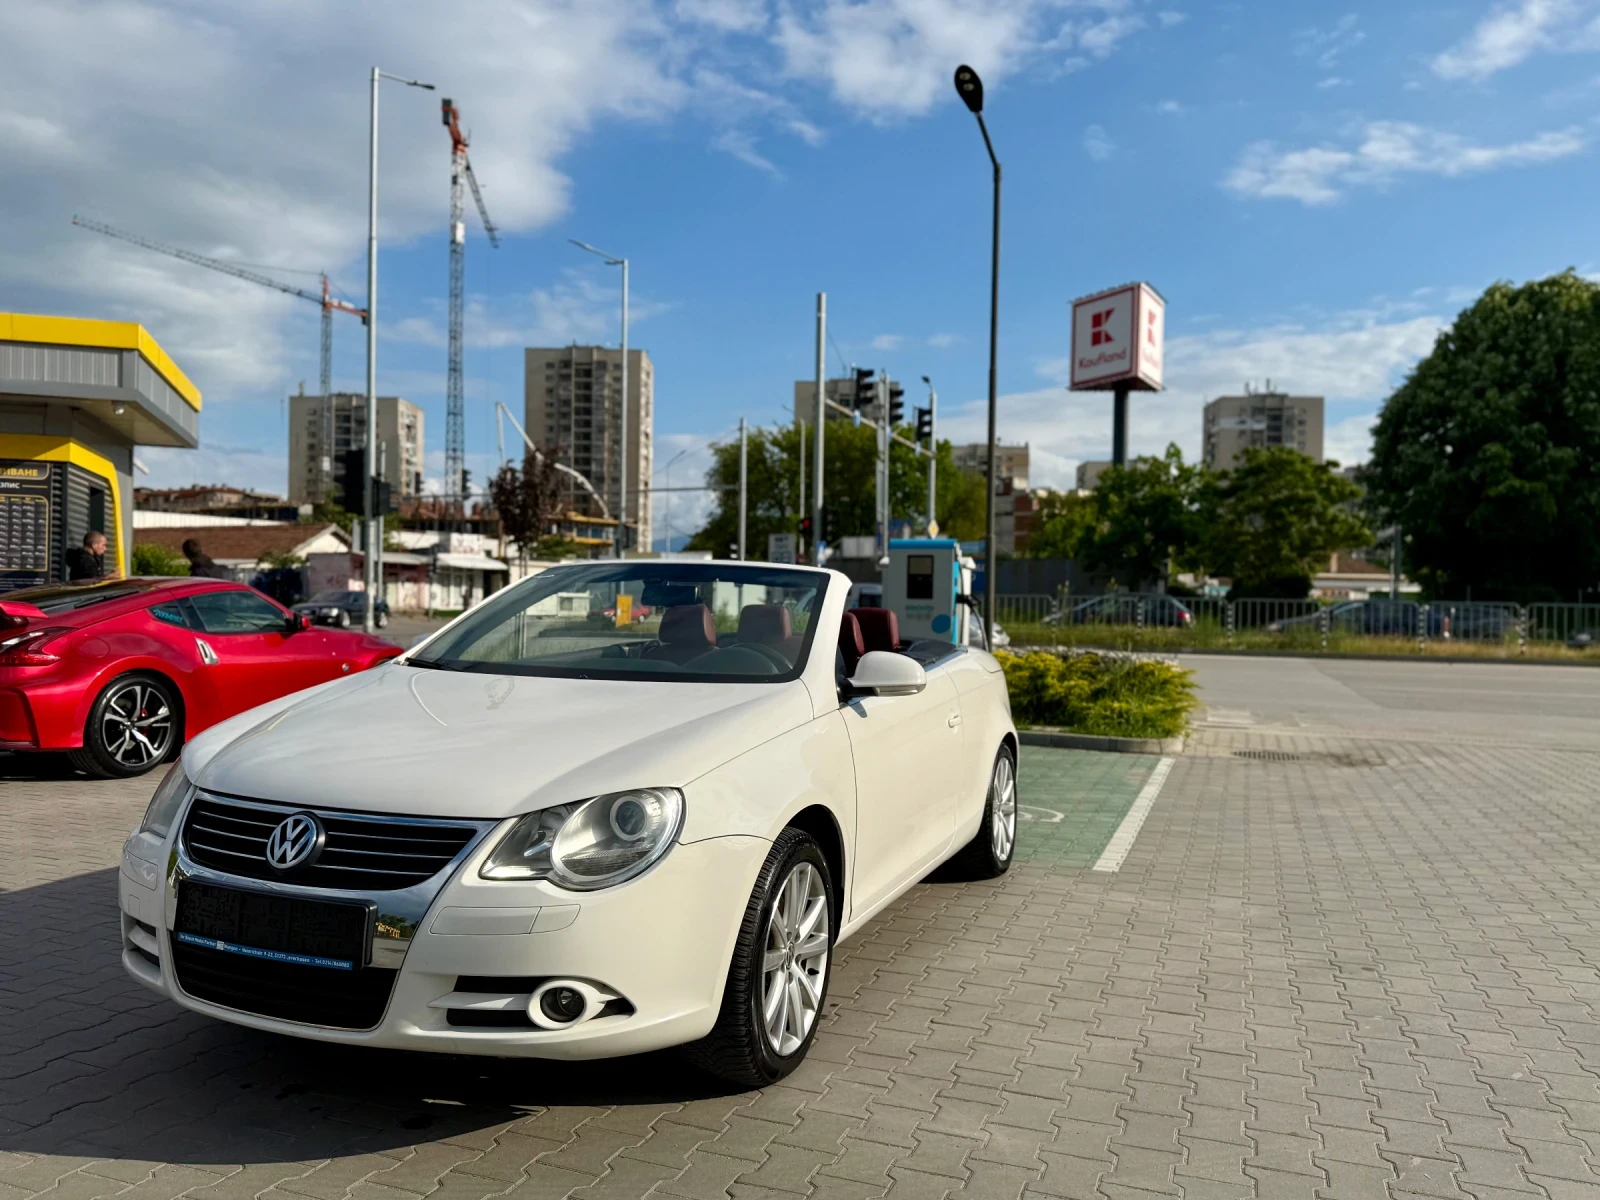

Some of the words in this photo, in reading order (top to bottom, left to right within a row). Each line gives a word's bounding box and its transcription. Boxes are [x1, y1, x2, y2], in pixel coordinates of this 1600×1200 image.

[1091, 307, 1116, 347] K
[1079, 347, 1127, 369] Kaufland
[266, 814, 317, 869] VW
